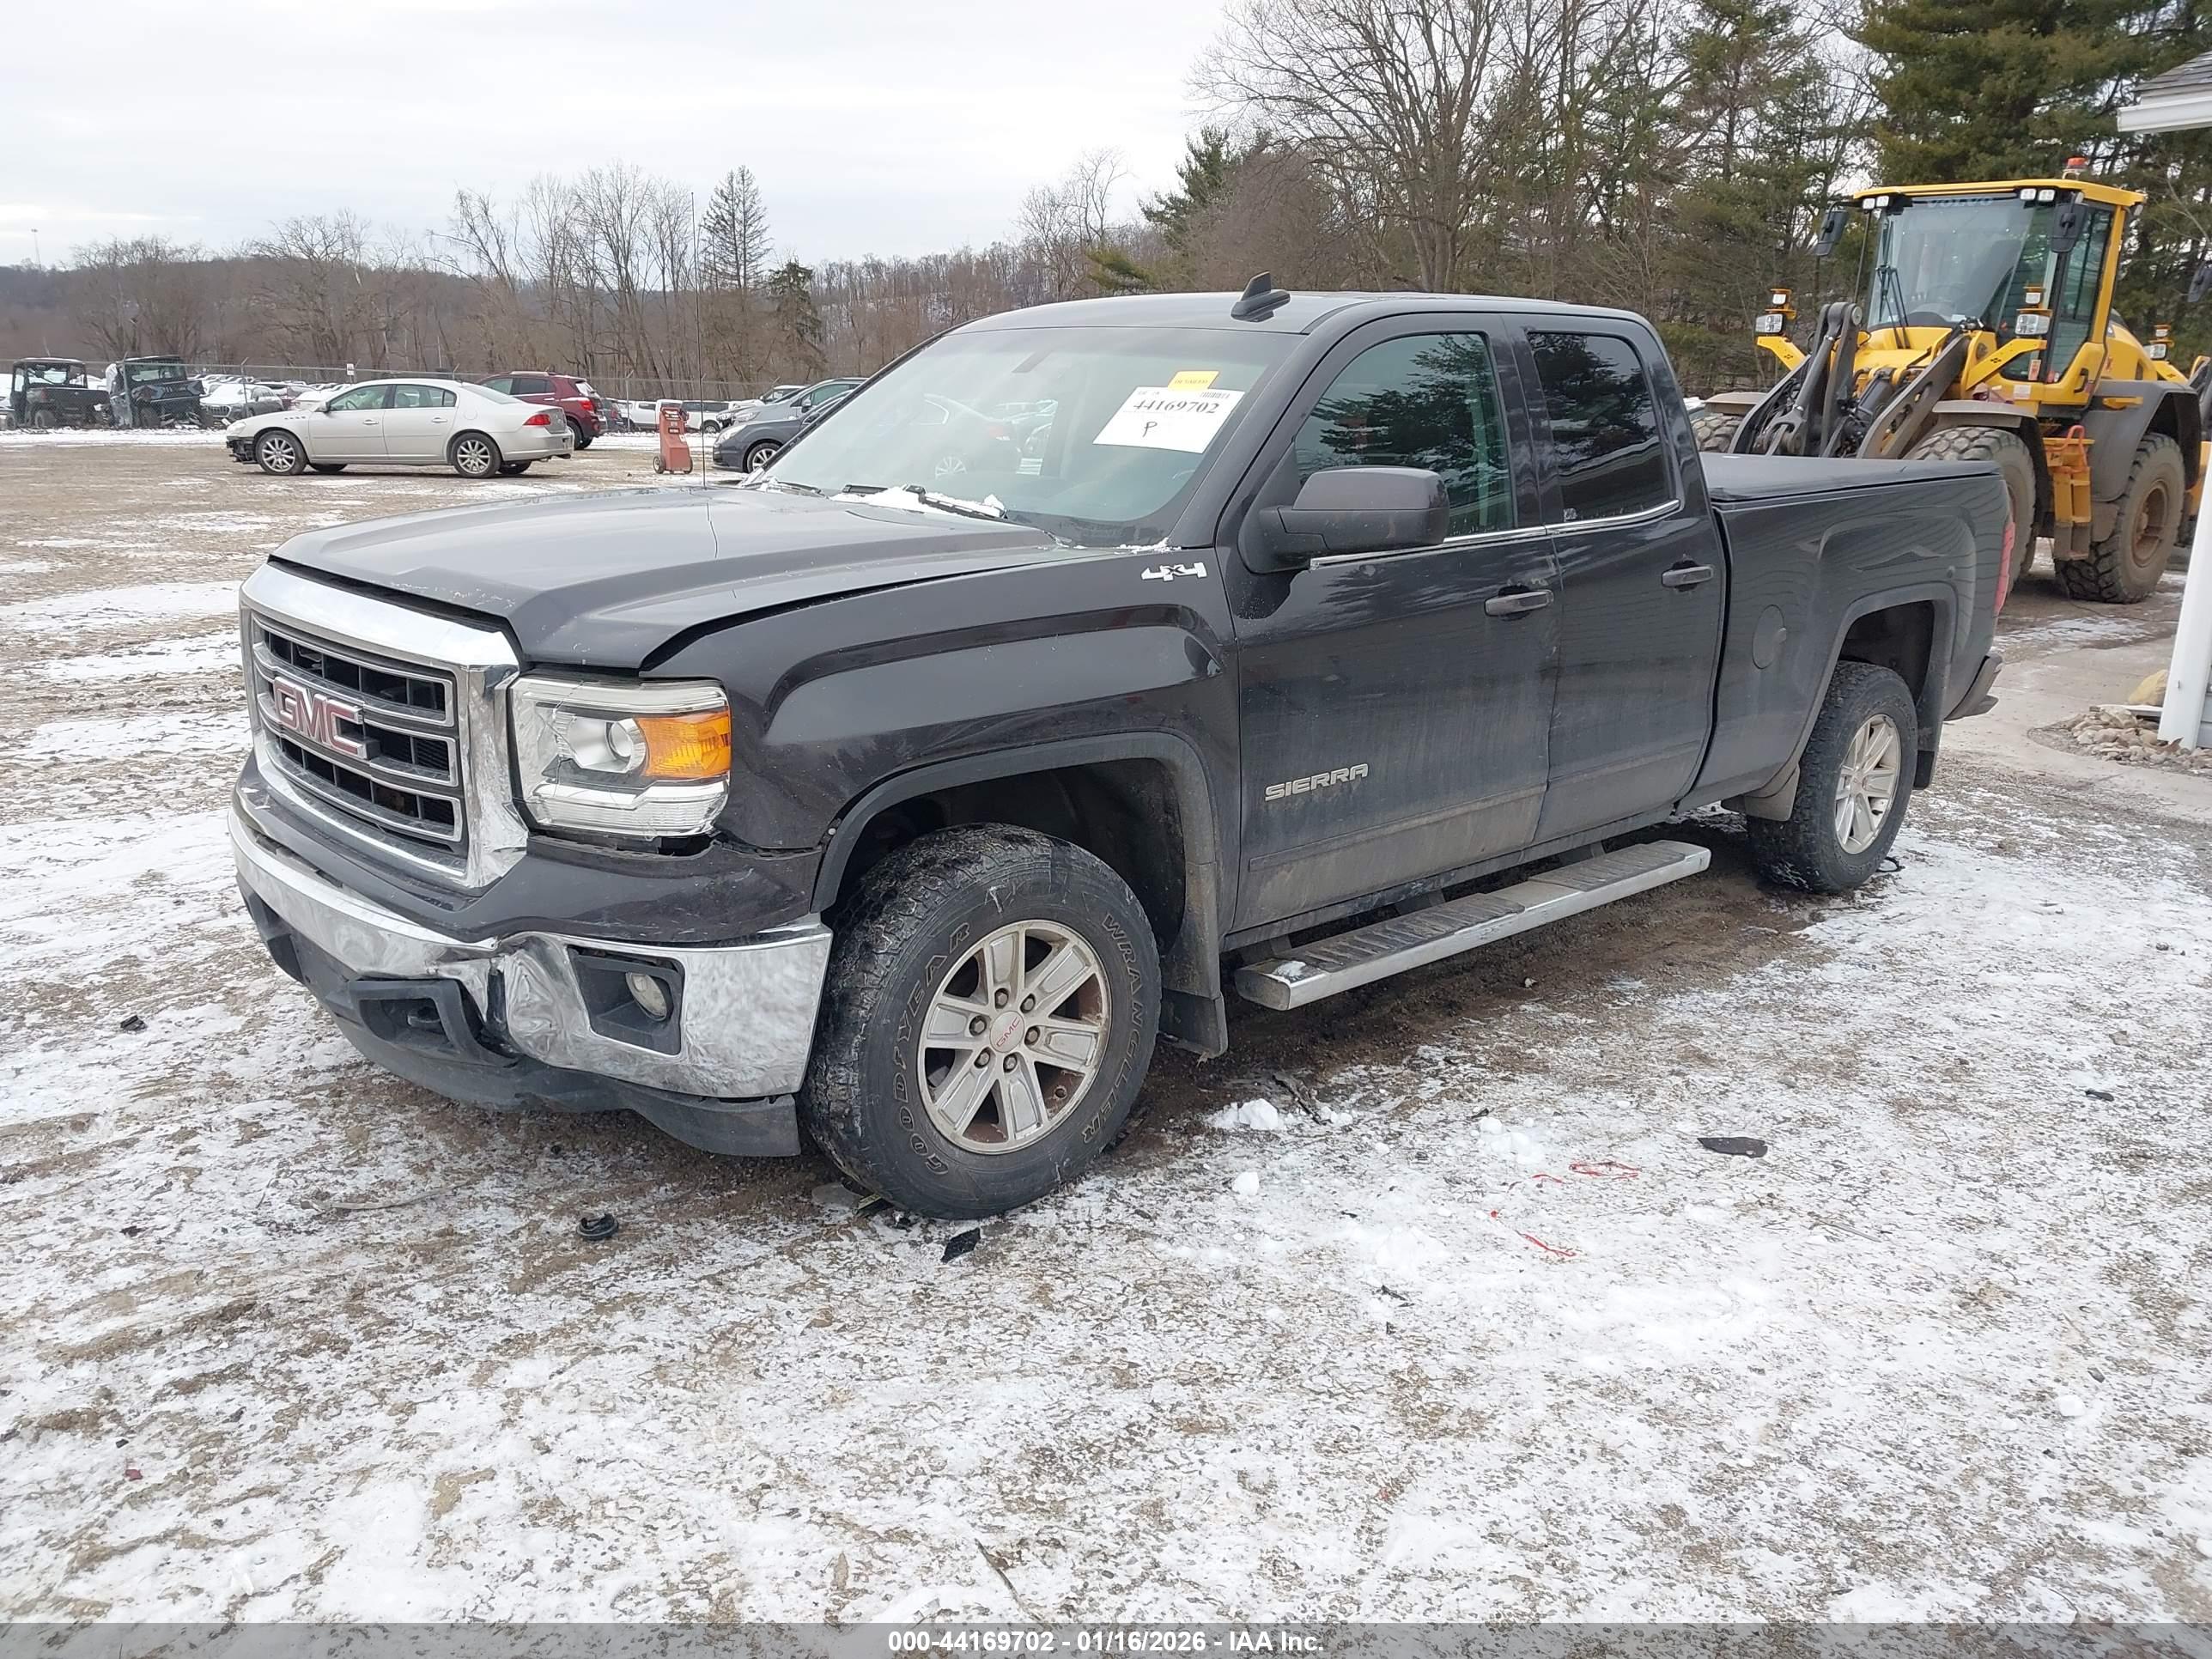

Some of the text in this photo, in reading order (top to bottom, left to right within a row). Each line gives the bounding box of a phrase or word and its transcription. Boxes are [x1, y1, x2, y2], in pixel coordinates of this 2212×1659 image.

[1927, 197, 1994, 208] VOLVO
[1133, 399, 1220, 414] 44169702
[273, 676, 368, 760] GMC
[1265, 763, 1369, 802] SIERRA
[996, 1016, 1021, 1047] GMC
[1080, 913, 1144, 1145] WRANGLER
